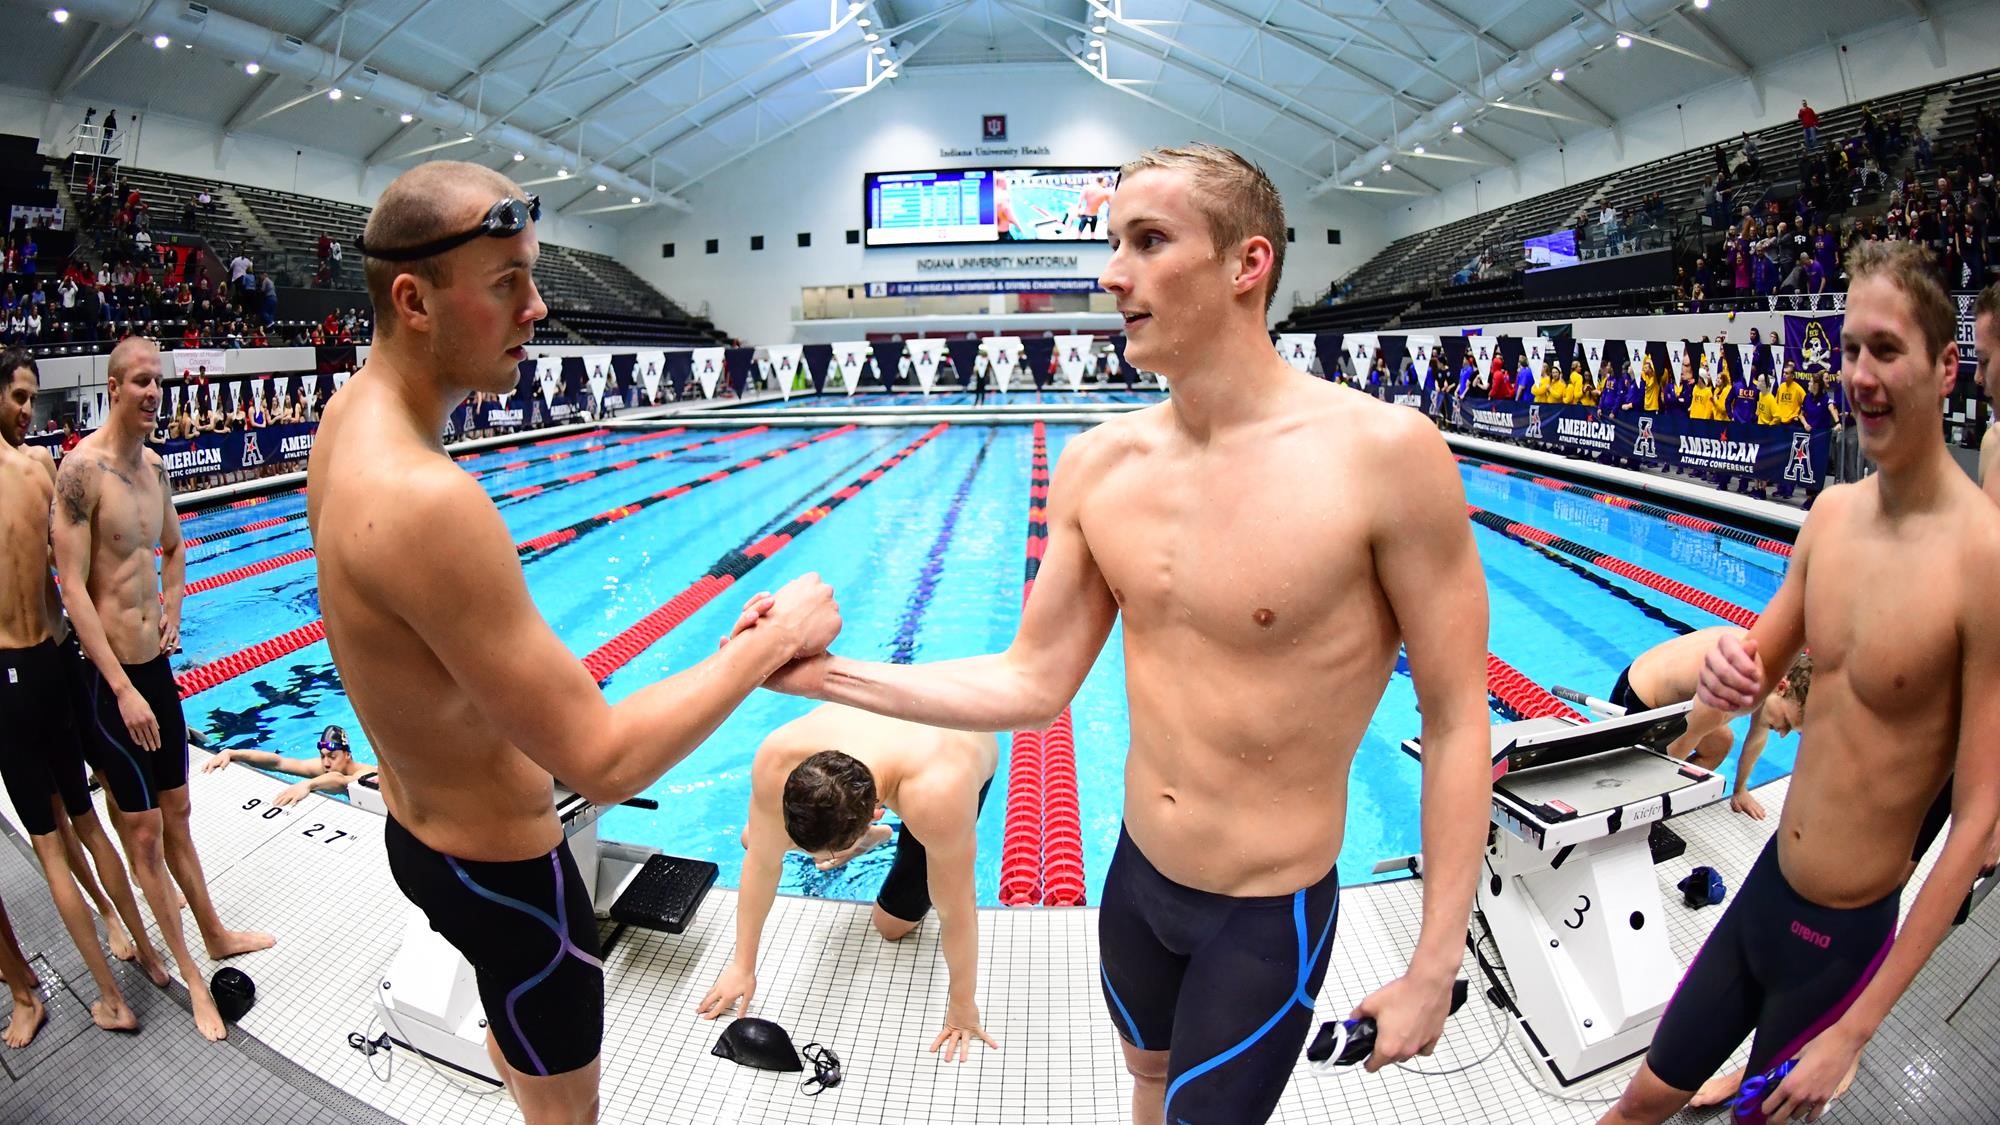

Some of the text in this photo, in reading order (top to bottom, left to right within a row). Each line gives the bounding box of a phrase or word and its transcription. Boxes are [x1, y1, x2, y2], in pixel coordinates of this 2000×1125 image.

[940, 146, 1051, 157] Indiana University Health
[917, 255, 1078, 270] INDIANA UNIVERSITY NATATORIUM
[914, 283, 952, 292] AMERICAN
[954, 283, 995, 291] SWIMMING
[1004, 281, 1031, 290] DIVING
[1032, 280, 1095, 290] CHAMPIONSHIPS
[1738, 388, 1754, 397] ECU
[488, 409, 523, 422] AMERICAN
[1472, 409, 1514, 427] AMERICAN
[1557, 417, 1615, 441] AMERICAN
[1633, 416, 1657, 458] A
[242, 431, 264, 467] A
[1559, 435, 1610, 450] ATHLETIC CONFERENCE
[1678, 434, 1760, 464] AMERICAN
[162, 447, 222, 471] MERICAN
[284, 450, 308, 459] ATHLETIC
[1784, 431, 1814, 484] A
[184, 463, 221, 476] CONFERENCE
[1681, 455, 1754, 474] ATHLETIC CONFERENCE
[1563, 894, 1591, 929] 3
[1791, 920, 1831, 949] arena
